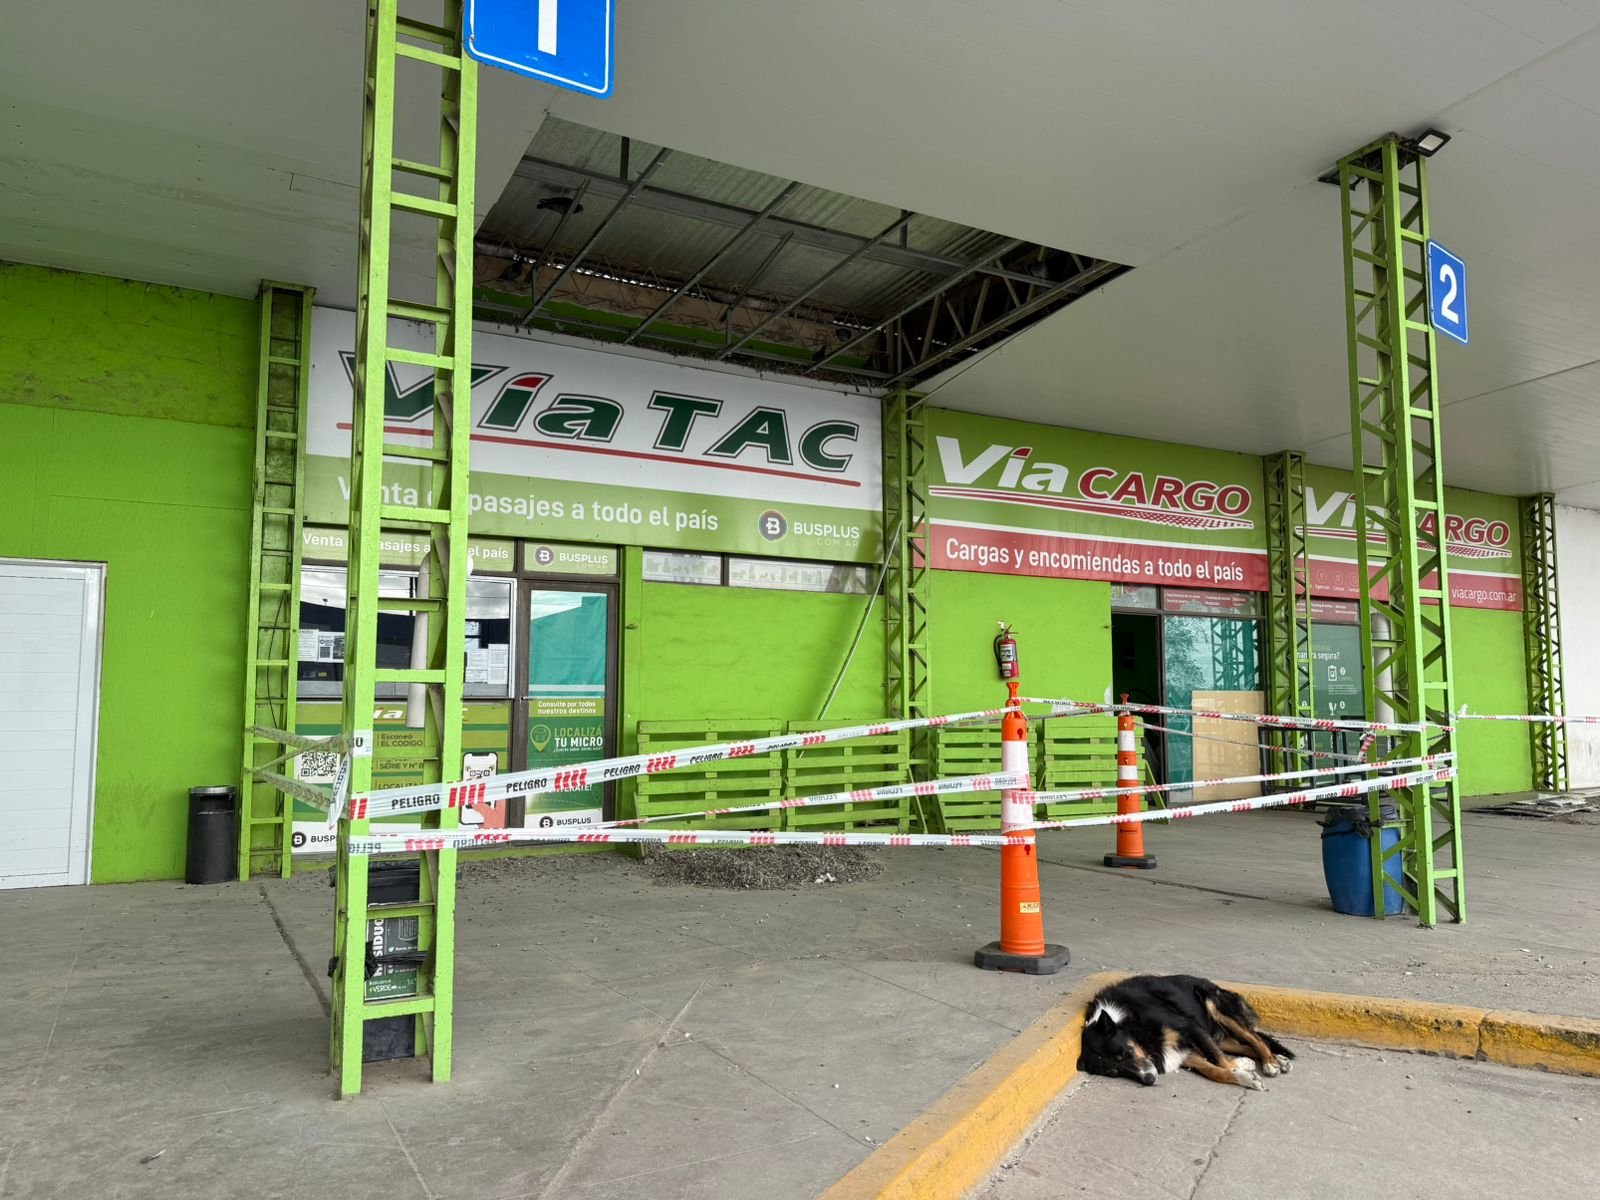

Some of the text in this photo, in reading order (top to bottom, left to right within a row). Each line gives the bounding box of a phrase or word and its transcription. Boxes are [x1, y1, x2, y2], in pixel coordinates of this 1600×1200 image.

[1439, 263, 1459, 324] 2
[648, 390, 859, 472] TAC
[935, 435, 1251, 517] Via CARGO
[469, 493, 563, 521] pasajes
[571, 502, 585, 520] a
[592, 499, 642, 525] todo
[650, 505, 669, 527] el
[676, 509, 719, 532] país
[793, 521, 860, 539] BUSPLUS
[1415, 511, 1511, 548] ARGO
[302, 533, 344, 547] Venta
[483, 546, 509, 559] país
[558, 552, 609, 565] BUSPLUS
[946, 537, 1244, 583] Cargas y encomiendas a todo el país
[1451, 585, 1518, 605] viacargo.com.ar
[538, 700, 596, 709] Consulte por todos
[554, 724, 603, 737] LOCALIZÁ
[555, 736, 604, 747] TU MICRO
[690, 753, 724, 765] PELIGRO
[603, 764, 641, 778] PELIGRO
[505, 777, 548, 794] PELIGRO
[391, 793, 441, 810] PELIGRO
[556, 817, 592, 826] BUSPLUS
